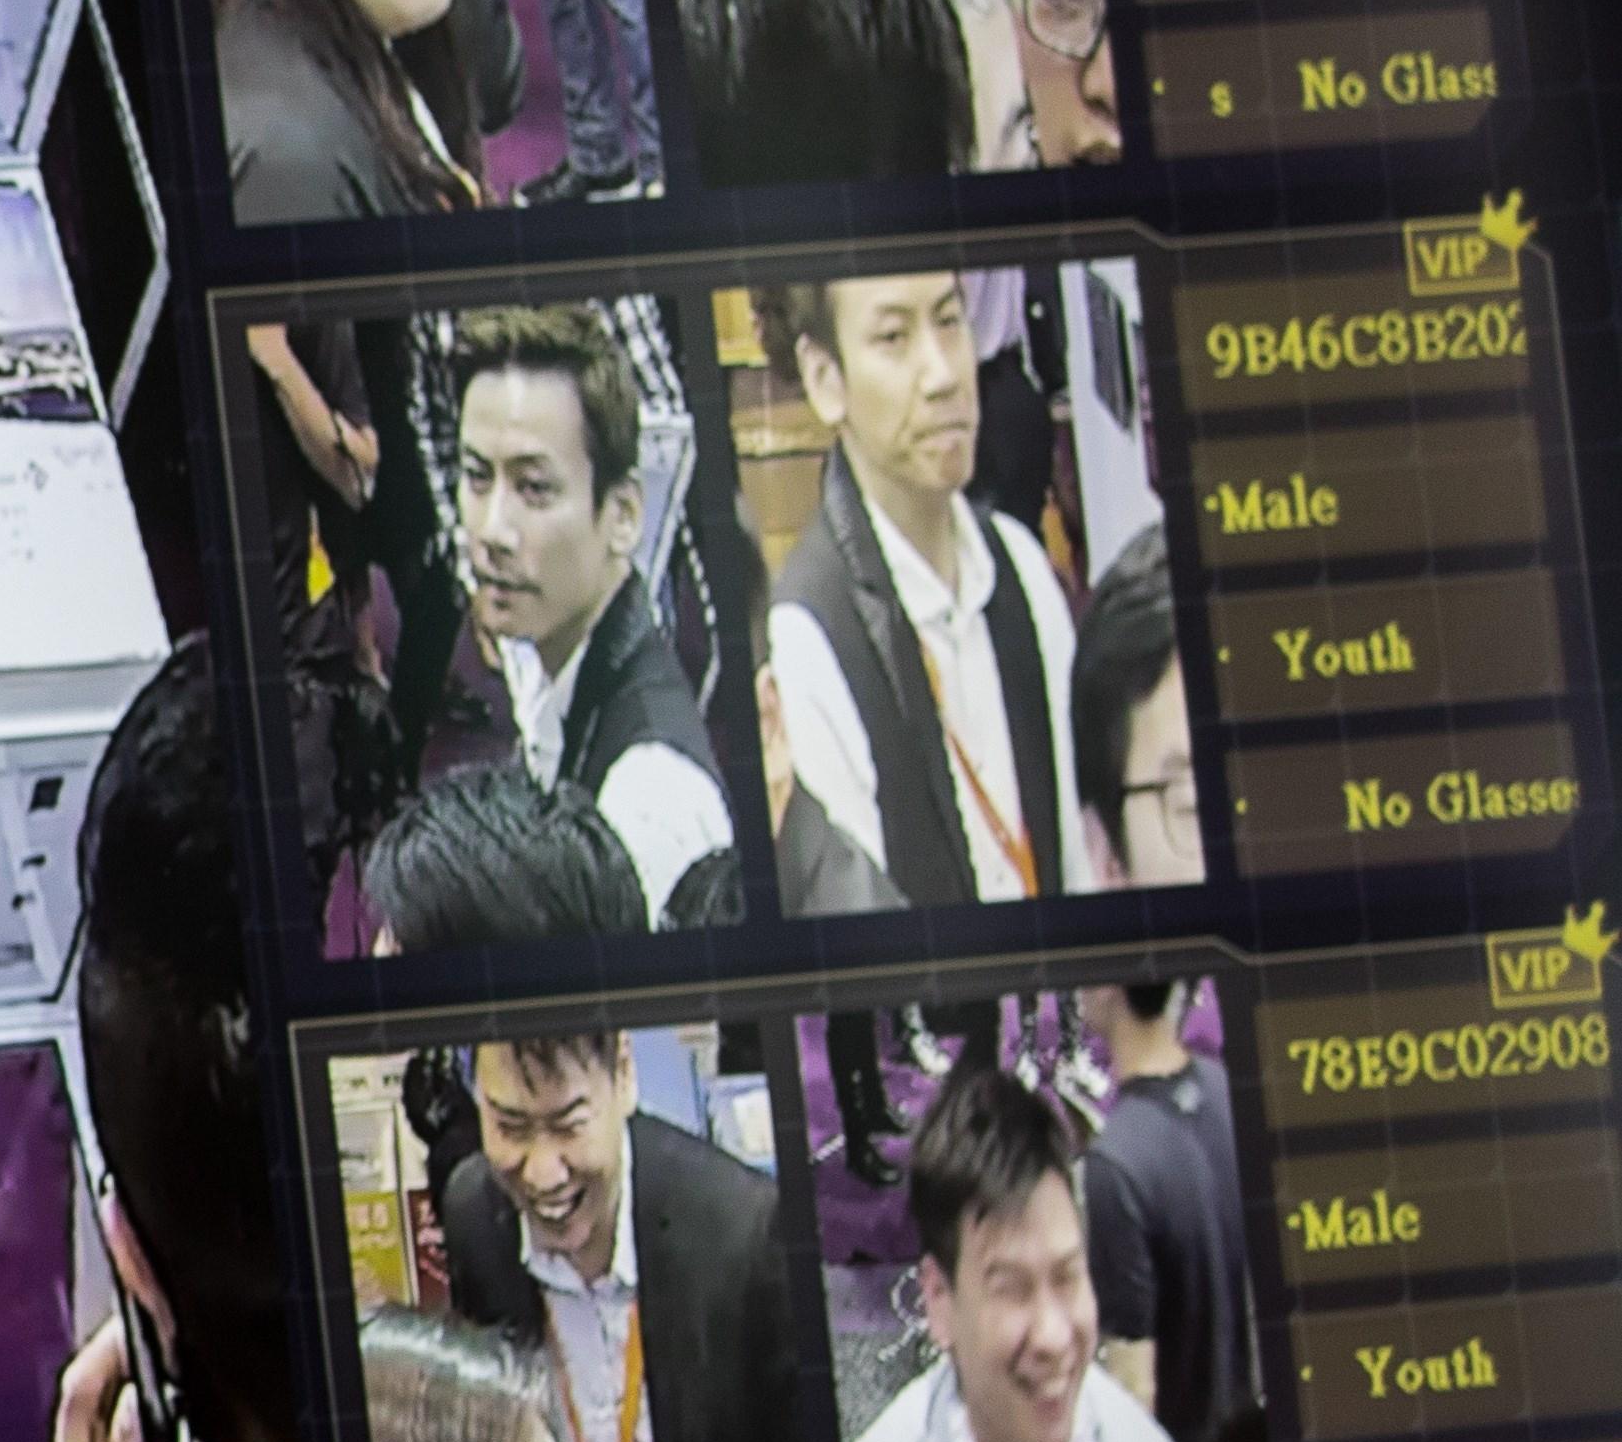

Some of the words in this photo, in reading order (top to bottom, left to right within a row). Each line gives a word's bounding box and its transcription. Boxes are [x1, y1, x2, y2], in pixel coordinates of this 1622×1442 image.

[1300, 60, 1365, 110] No
[1416, 236, 1490, 280] VIP
[1218, 475, 1336, 533] Male
[1274, 624, 1413, 680] Youth
[1344, 781, 1411, 830] No
[1499, 948, 1572, 991] VIP
[1301, 1190, 1419, 1251] Male
[1356, 1340, 1495, 1397] Youth
